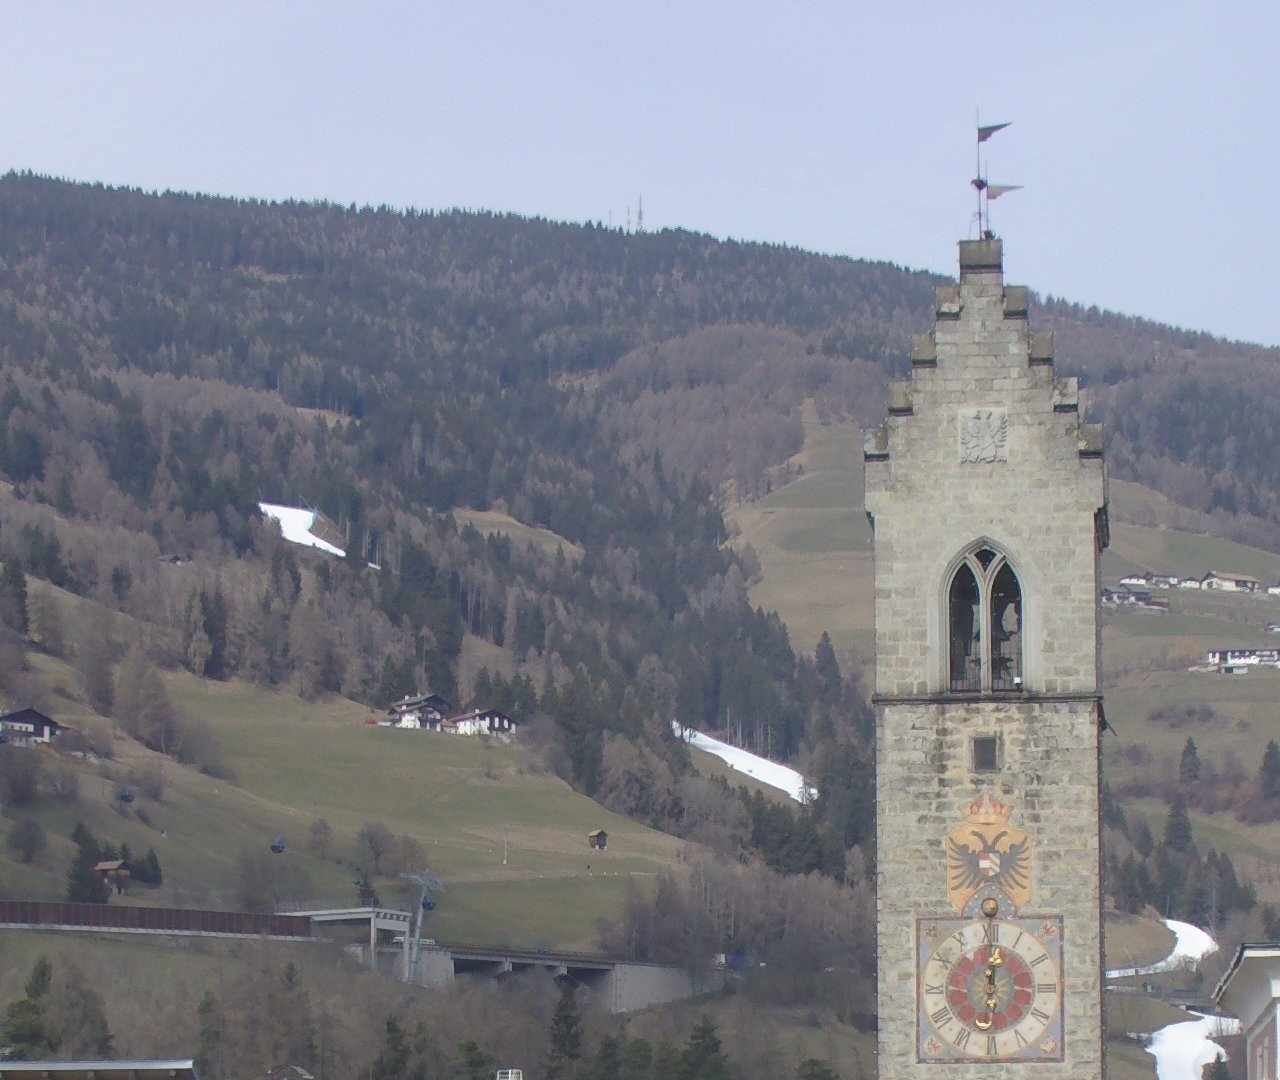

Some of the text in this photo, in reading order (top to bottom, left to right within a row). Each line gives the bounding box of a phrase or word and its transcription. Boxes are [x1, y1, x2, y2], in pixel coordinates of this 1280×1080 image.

[1029, 953, 1049, 968] II
[925, 984, 945, 995] IX
[1036, 983, 1057, 994] III
